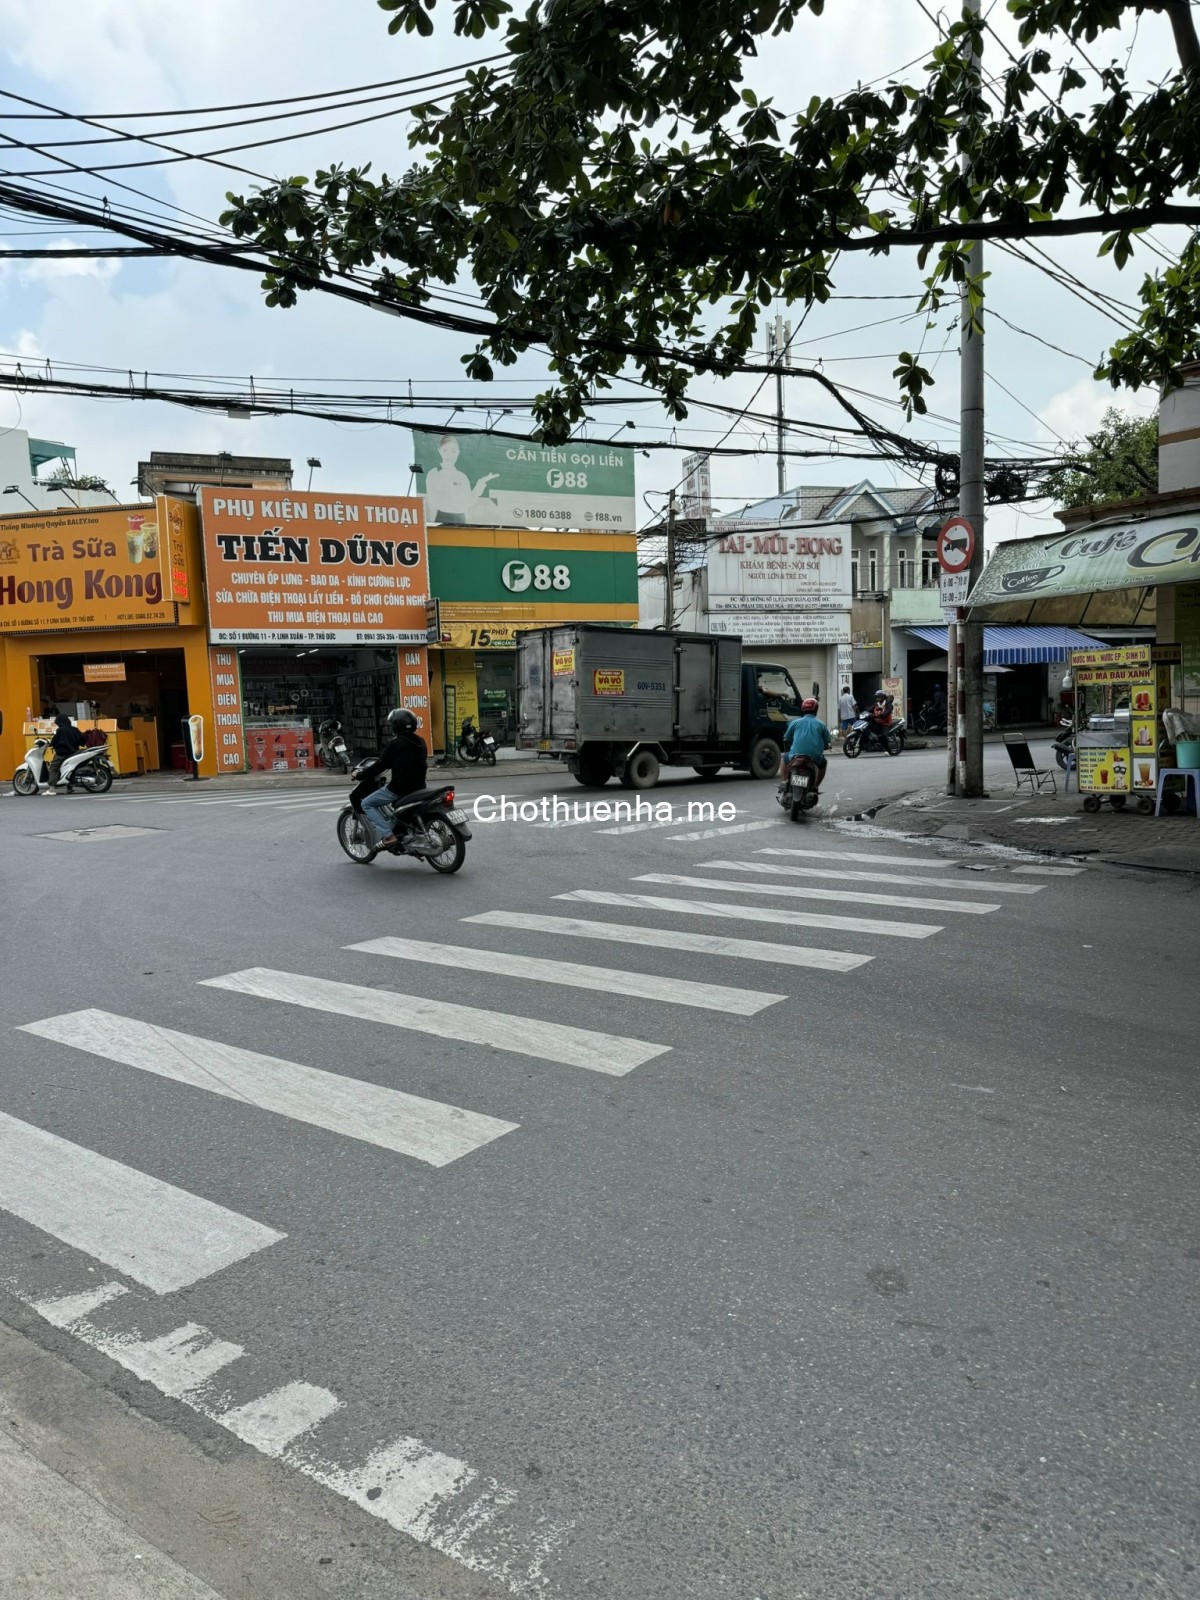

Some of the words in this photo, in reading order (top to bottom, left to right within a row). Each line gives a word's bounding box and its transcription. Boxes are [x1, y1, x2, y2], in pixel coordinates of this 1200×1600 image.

[506, 446, 536, 462] CẦN
[540, 447, 567, 464] TIỀN
[570, 454, 595, 468] GỌI
[599, 450, 624, 467] LIỀN
[546, 468, 588, 489] F88
[213, 498, 254, 521] PHỤ
[260, 497, 309, 523] KIỆN
[313, 500, 359, 525] ĐIỆN
[364, 505, 419, 528] THOẠI
[525, 510, 547, 519] 1800
[549, 510, 572, 520] 6388
[595, 512, 622, 522] f88.vn
[27, 540, 65, 563] Trà
[72, 537, 117, 559] Sữa
[217, 526, 310, 564] TIẾN
[319, 533, 420, 568] DŨNG
[1059, 529, 1138, 560] Café
[740, 560, 764, 570] KHÁM
[766, 560, 788, 570] BỆNH
[806, 561, 820, 570] SOI
[231, 570, 266, 585] CHUYÊN
[267, 569, 279, 585] ỐP
[281, 572, 303, 585] LƯNG
[310, 574, 327, 586] BAO
[329, 575, 340, 587] DA
[347, 573, 367, 587] KÍNH
[368, 573, 395, 588] CƯỜNG
[396, 576, 411, 591] LỰC
[502, 560, 571, 593] F88
[1007, 573, 1039, 588] Coffee
[0, 575, 74, 610] Hong
[84, 569, 163, 605] Kong
[215, 587, 234, 603] SỬA
[235, 590, 260, 604] CHỮA
[260, 590, 281, 607] ĐIỆN
[282, 593, 307, 607] THOẠI
[309, 589, 324, 605] LẤY
[363, 594, 382, 606] CHƠI
[384, 592, 405, 606] CÔNG
[406, 593, 427, 609] NGHỆ
[267, 611, 284, 623] THU
[285, 611, 305, 623] MUA
[306, 609, 326, 626] ĐIỆN
[327, 612, 351, 626] THOẠI
[352, 610, 367, 624] GIÁ
[367, 612, 384, 624] CAO
[469, 629, 491, 647] 15
[216, 653, 232, 666] THU
[216, 674, 235, 686] MUA
[1079, 672, 1093, 681] RAU
[1127, 669, 1150, 678] XANH
[217, 691, 237, 709] ĐIỆN
[217, 713, 241, 728] THOẠI
[223, 732, 238, 746] GIÁ
[223, 752, 240, 765] CAO
